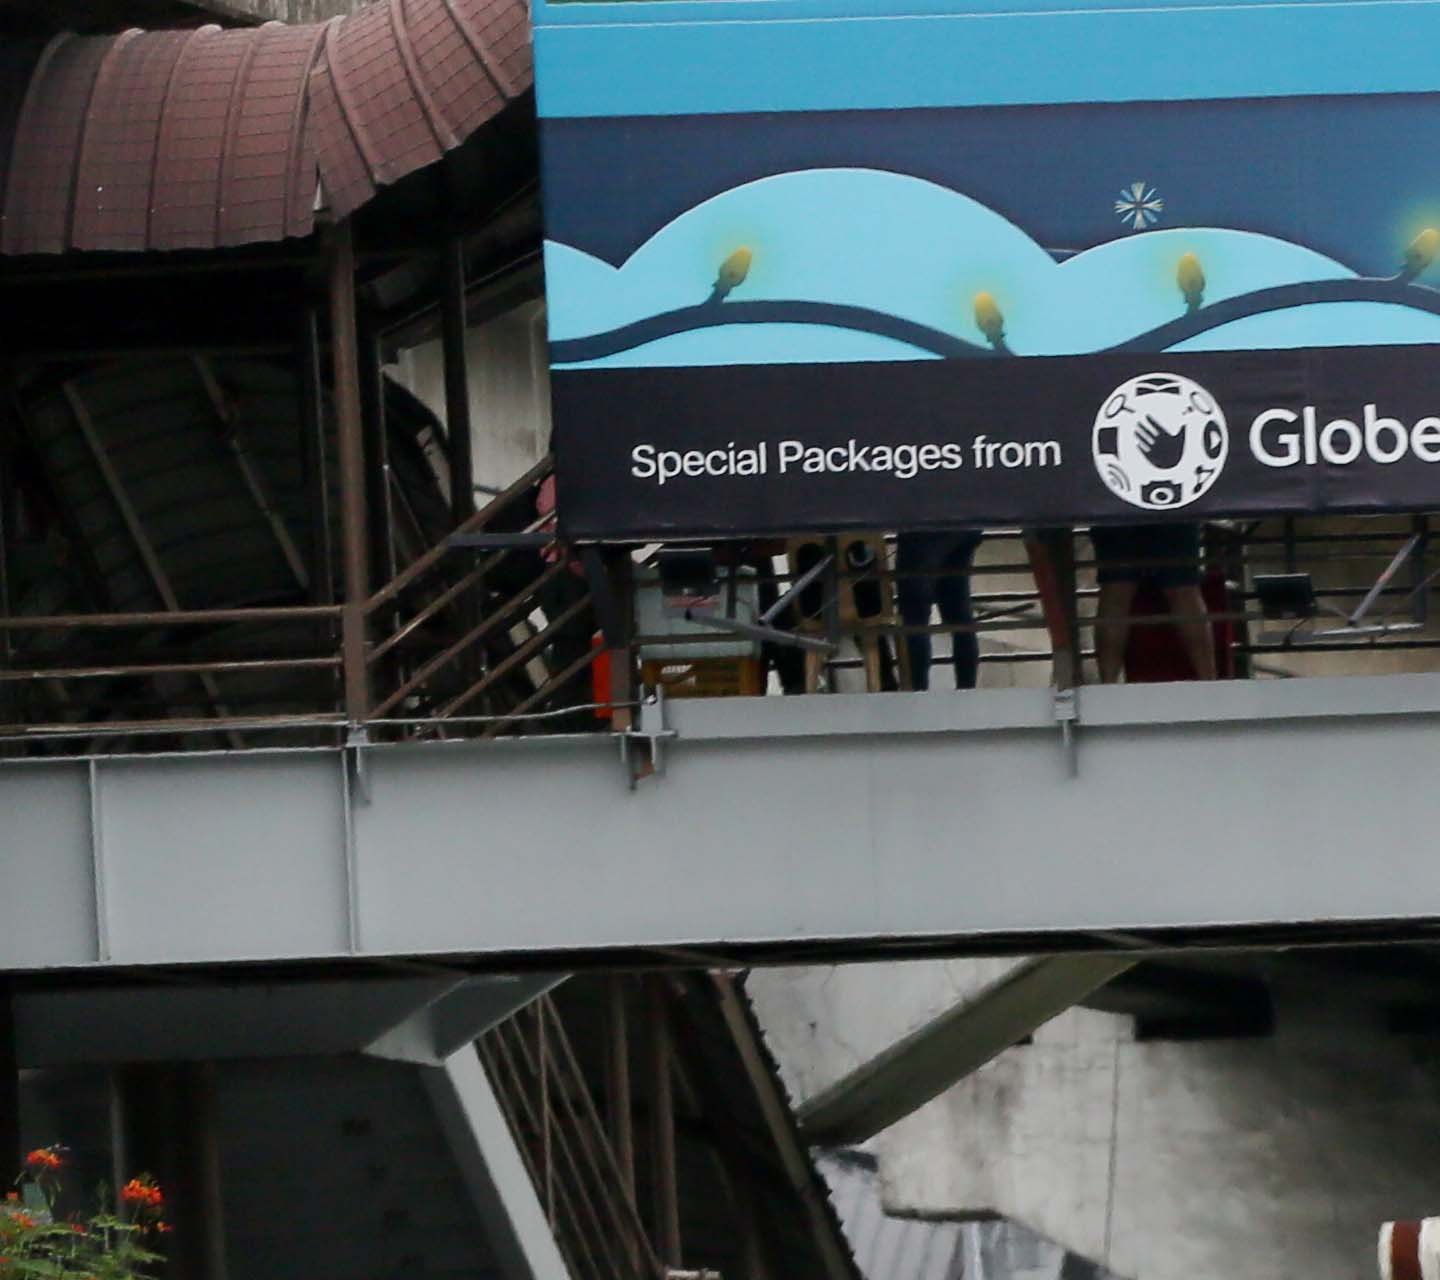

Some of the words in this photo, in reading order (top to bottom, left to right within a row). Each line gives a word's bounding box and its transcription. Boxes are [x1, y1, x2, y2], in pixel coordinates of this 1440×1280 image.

[631, 440, 768, 485] Special
[777, 435, 961, 478] Packages
[971, 434, 1062, 470] from
